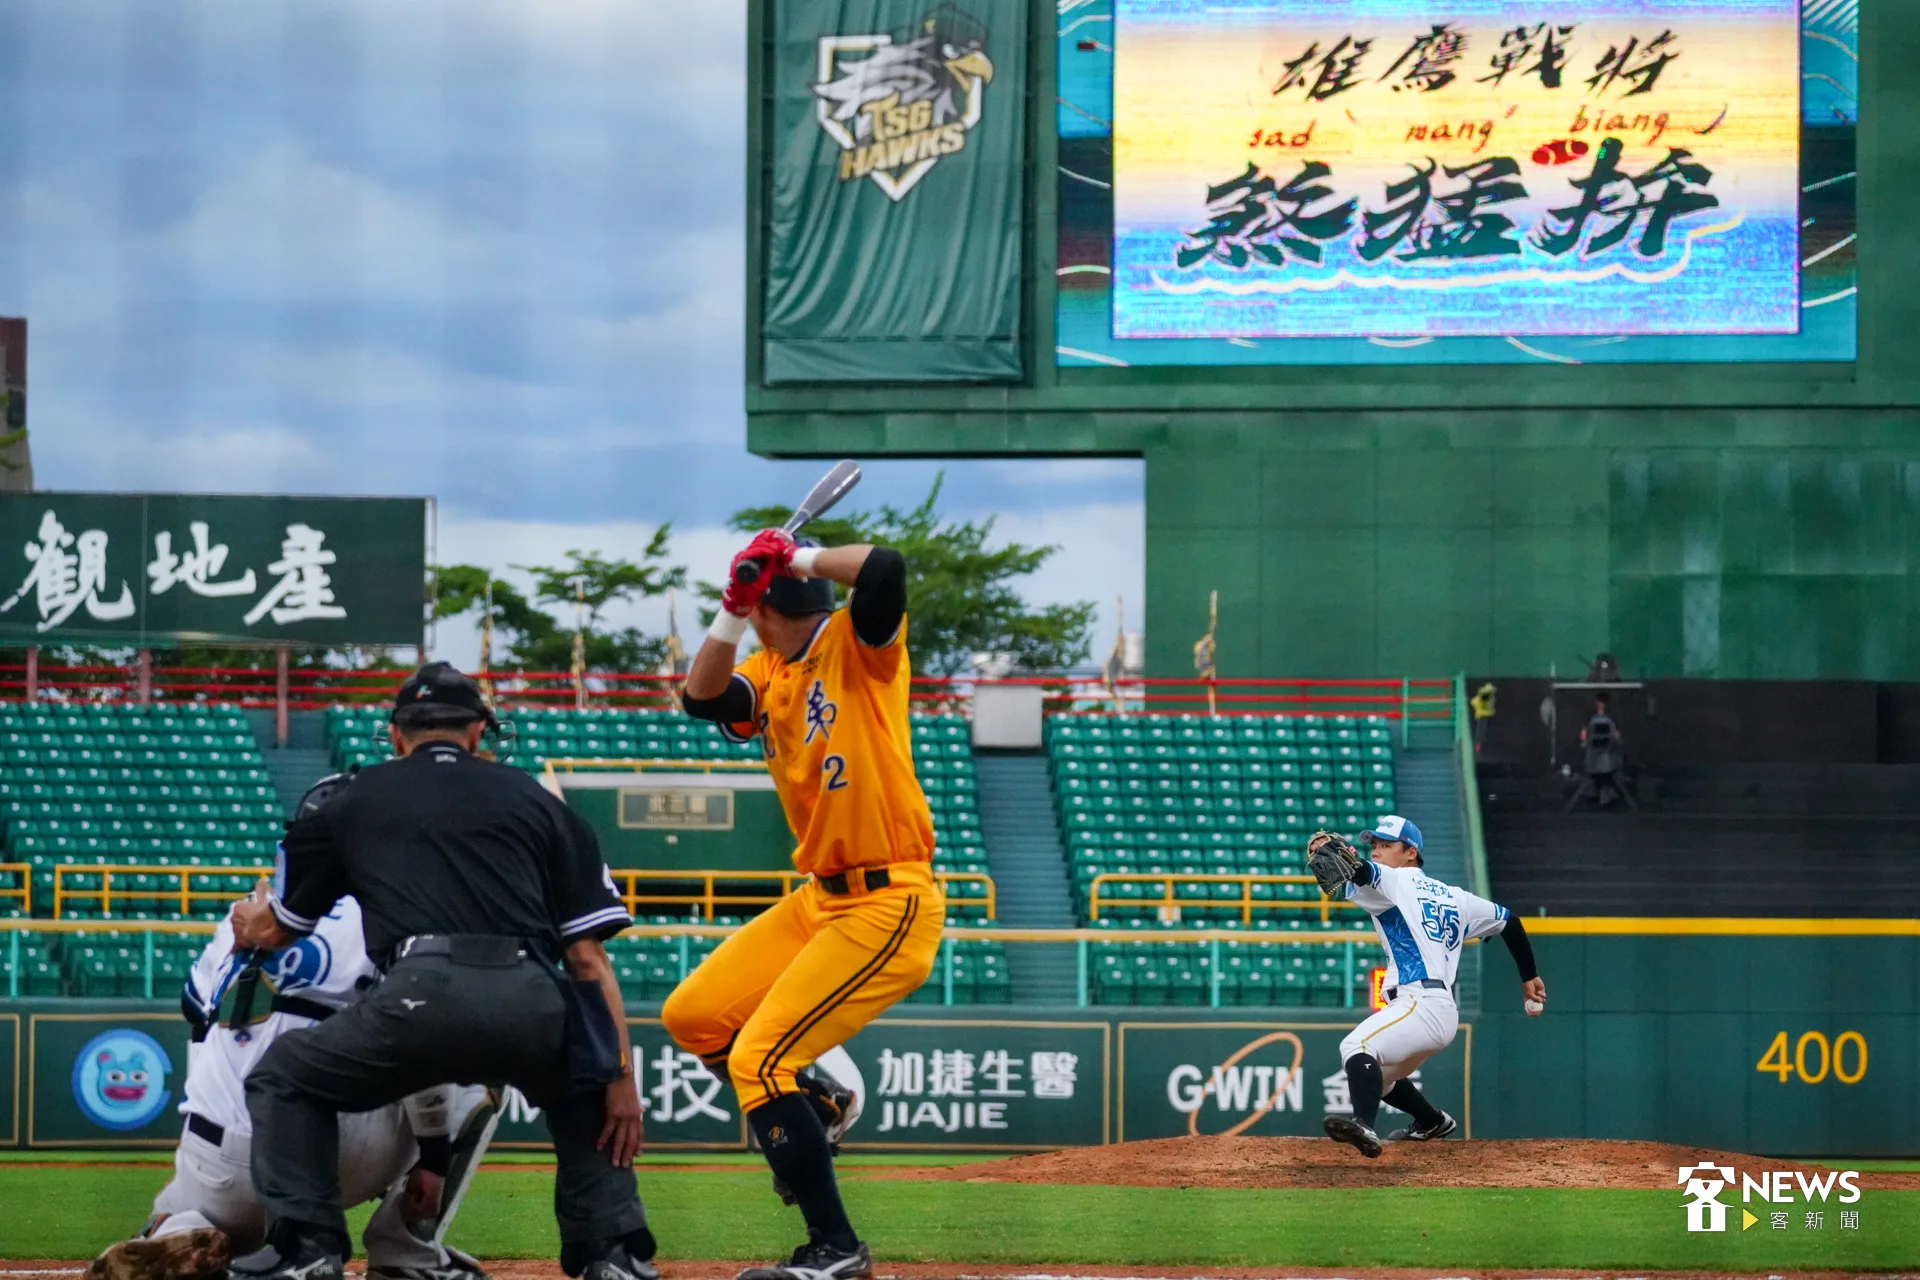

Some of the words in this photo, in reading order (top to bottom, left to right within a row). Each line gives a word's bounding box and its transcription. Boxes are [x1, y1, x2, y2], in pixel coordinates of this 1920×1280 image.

[1273, 22, 1682, 101] 雄鷹戰將
[859, 93, 932, 142] TSG
[839, 124, 966, 182] HAWKS
[823, 754, 849, 791] 2
[1417, 897, 1460, 952] 55
[876, 1048, 1078, 1099] 加捷生醫
[1756, 1030, 1869, 1084] 400
[876, 1101, 1008, 1133] JIAJIE
